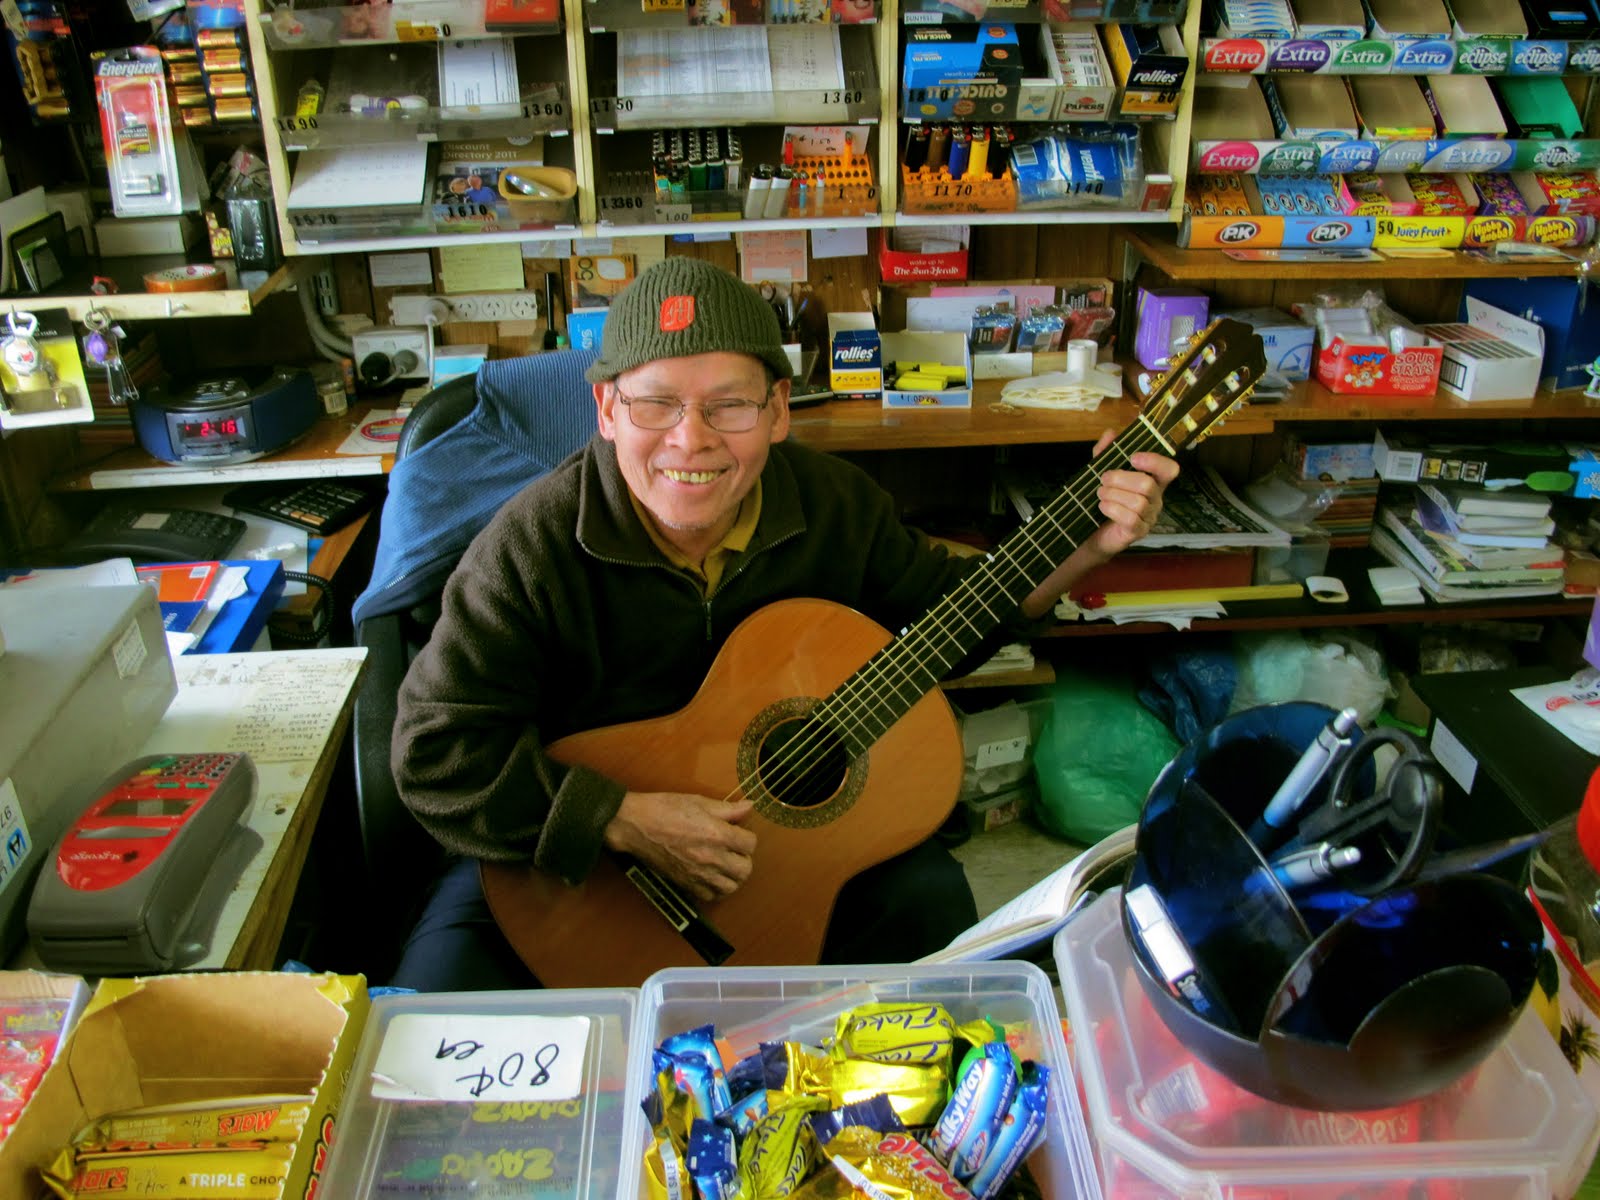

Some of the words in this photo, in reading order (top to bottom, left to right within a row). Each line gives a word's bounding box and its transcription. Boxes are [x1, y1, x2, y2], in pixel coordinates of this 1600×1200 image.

[1210, 48, 1262, 65] Extra
[1276, 46, 1326, 62] Extra
[1340, 48, 1385, 64] Extra
[1402, 50, 1446, 64] Extra
[1459, 49, 1506, 68] eclipse
[1516, 48, 1562, 68] eclipse
[98, 60, 158, 76] Energizer
[1133, 70, 1178, 83] rollies
[443, 143, 490, 151] Discount
[1272, 148, 1316, 160] Extra
[1331, 148, 1373, 160] Extra
[443, 151, 493, 160] Directory
[494, 151, 518, 159] 2011
[1206, 152, 1254, 167] Extra
[1384, 150, 1423, 161] Extra
[1448, 148, 1502, 163] Extra
[1534, 148, 1581, 168] eclipse
[1394, 226, 1420, 237] Juicy
[1421, 226, 1446, 237] Fruit
[575, 257, 594, 280] 50
[894, 266, 910, 276] The
[912, 266, 929, 274] Sun
[930, 266, 959, 276] Herald
[834, 346, 874, 360] rollies
[1348, 352, 1386, 366] TNT
[1396, 352, 1435, 365] SOUR
[1391, 364, 1434, 376] STRAPS
[200, 420, 236, 436] 2:16
[854, 1007, 938, 1033] Flake
[218, 1108, 280, 1136] Mars
[189, 1173, 246, 1187] TRIPLE
